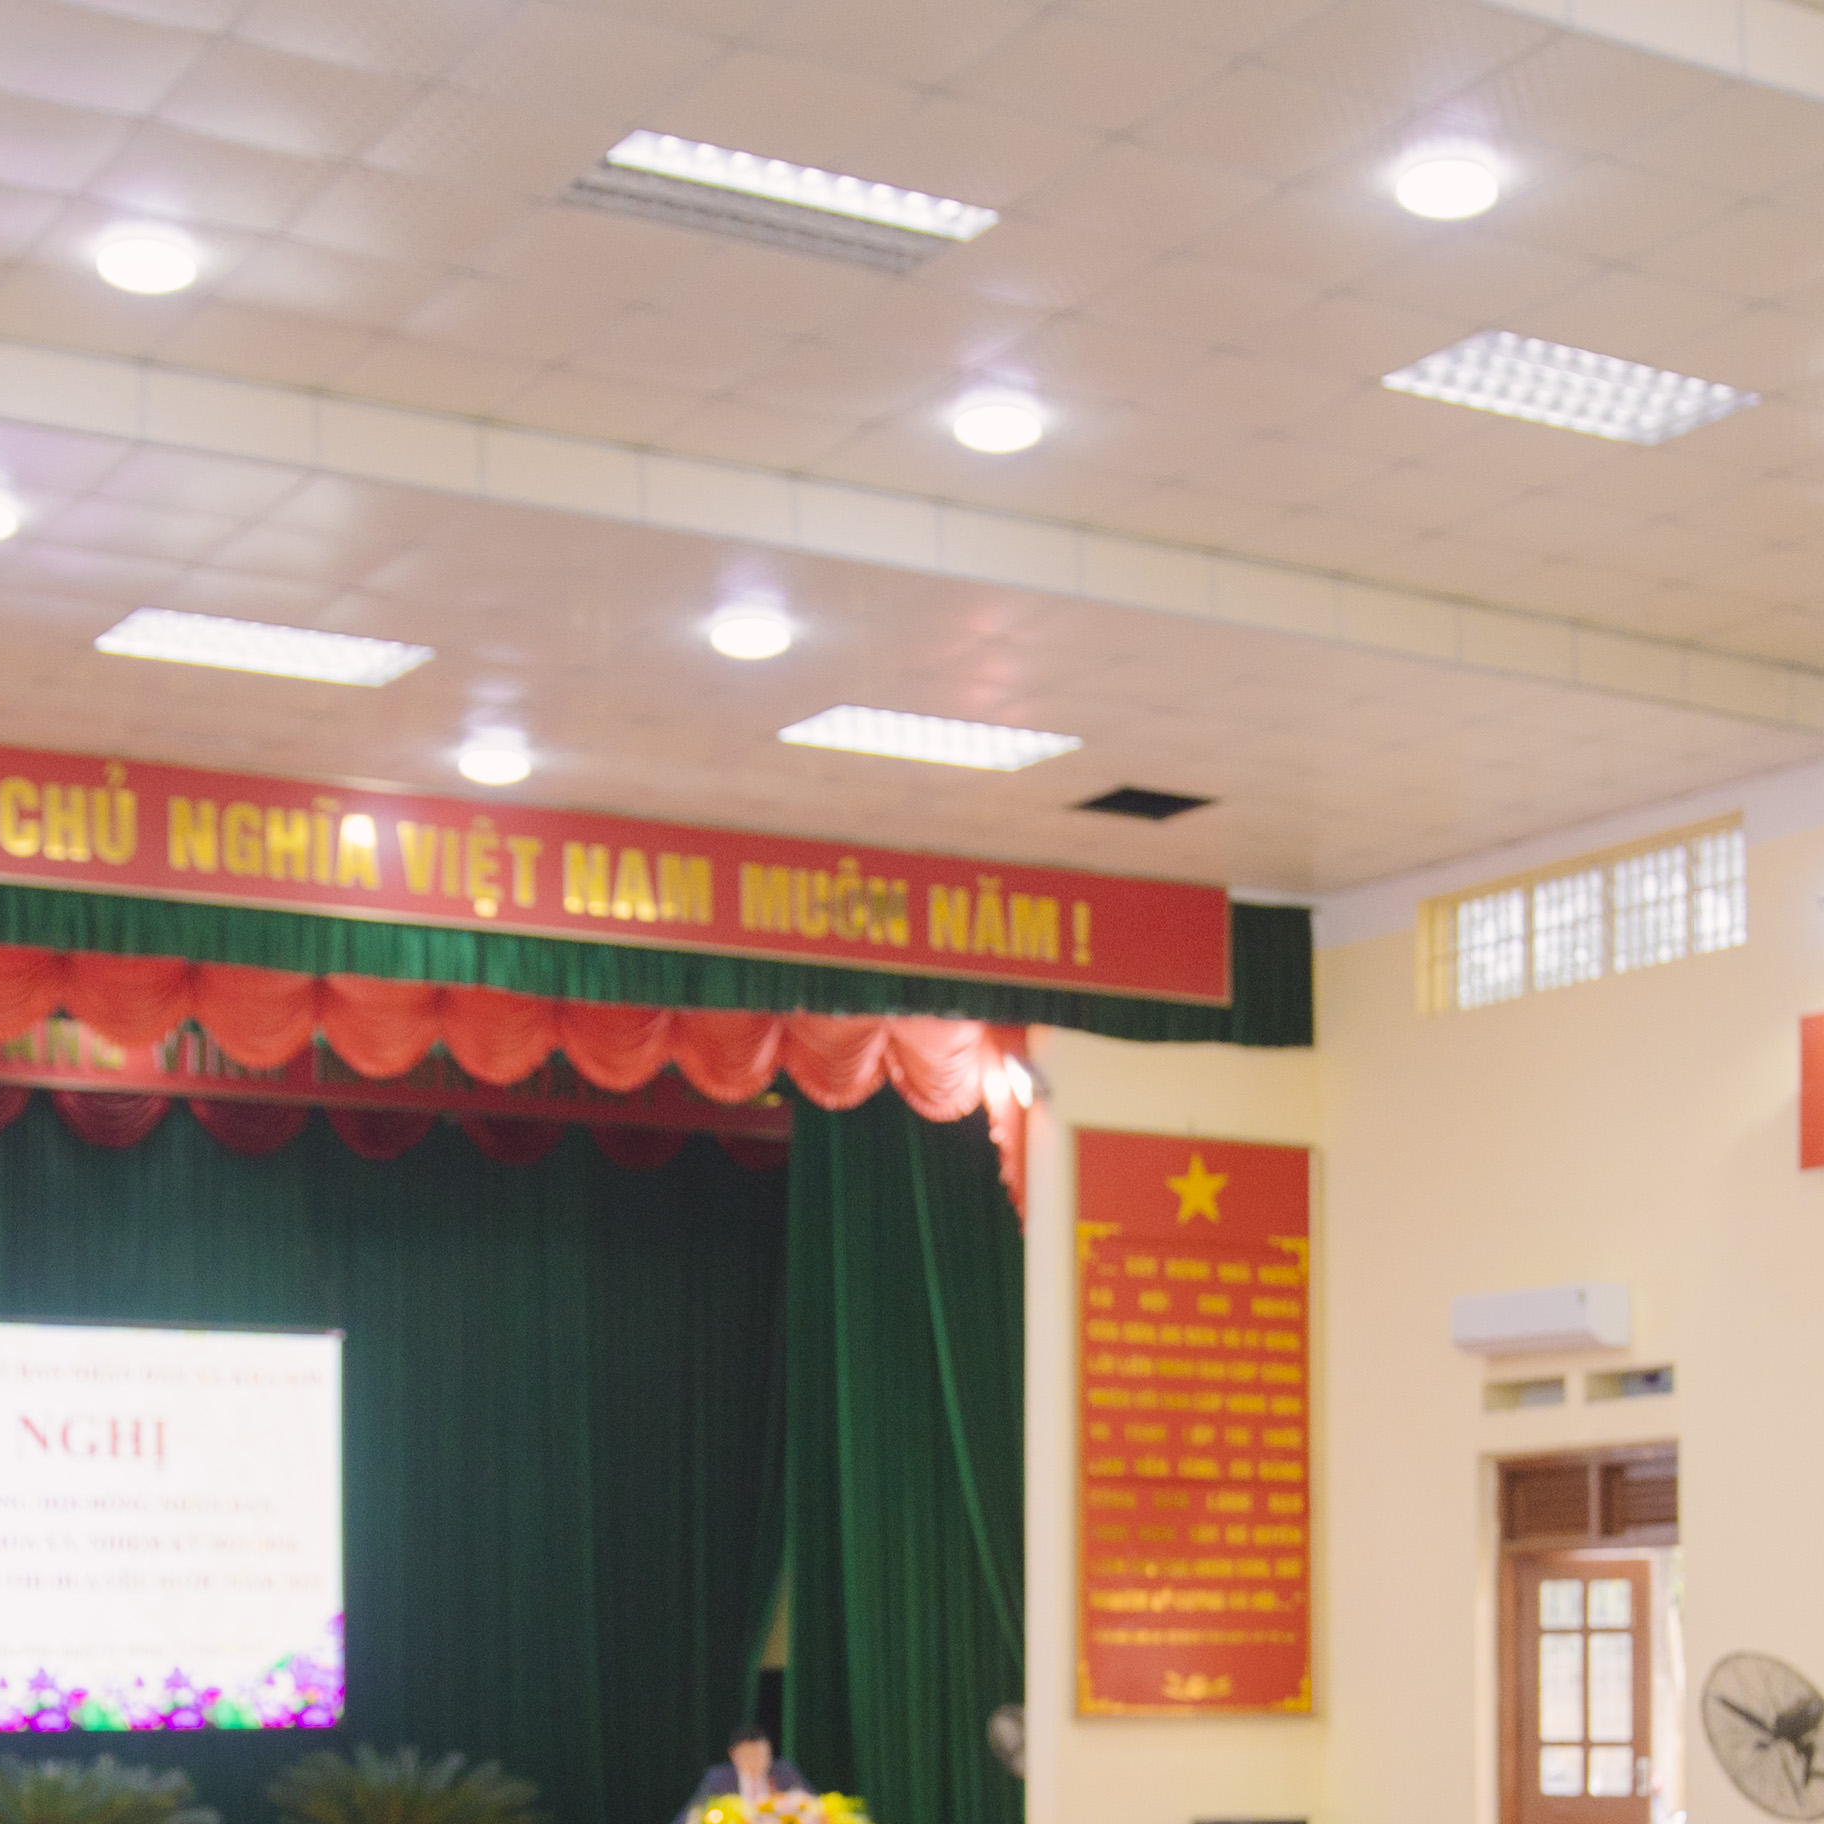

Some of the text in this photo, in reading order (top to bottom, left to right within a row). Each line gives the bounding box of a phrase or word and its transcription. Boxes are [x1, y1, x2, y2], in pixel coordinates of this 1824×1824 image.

[169, 794, 379, 890] NGHĨA
[397, 815, 539, 917] VIỆT
[565, 844, 711, 924] NAM
[741, 859, 907, 944] MUÔN
[929, 876, 1061, 963] NĂM
[17, 1412, 169, 1472] NGHỊ
